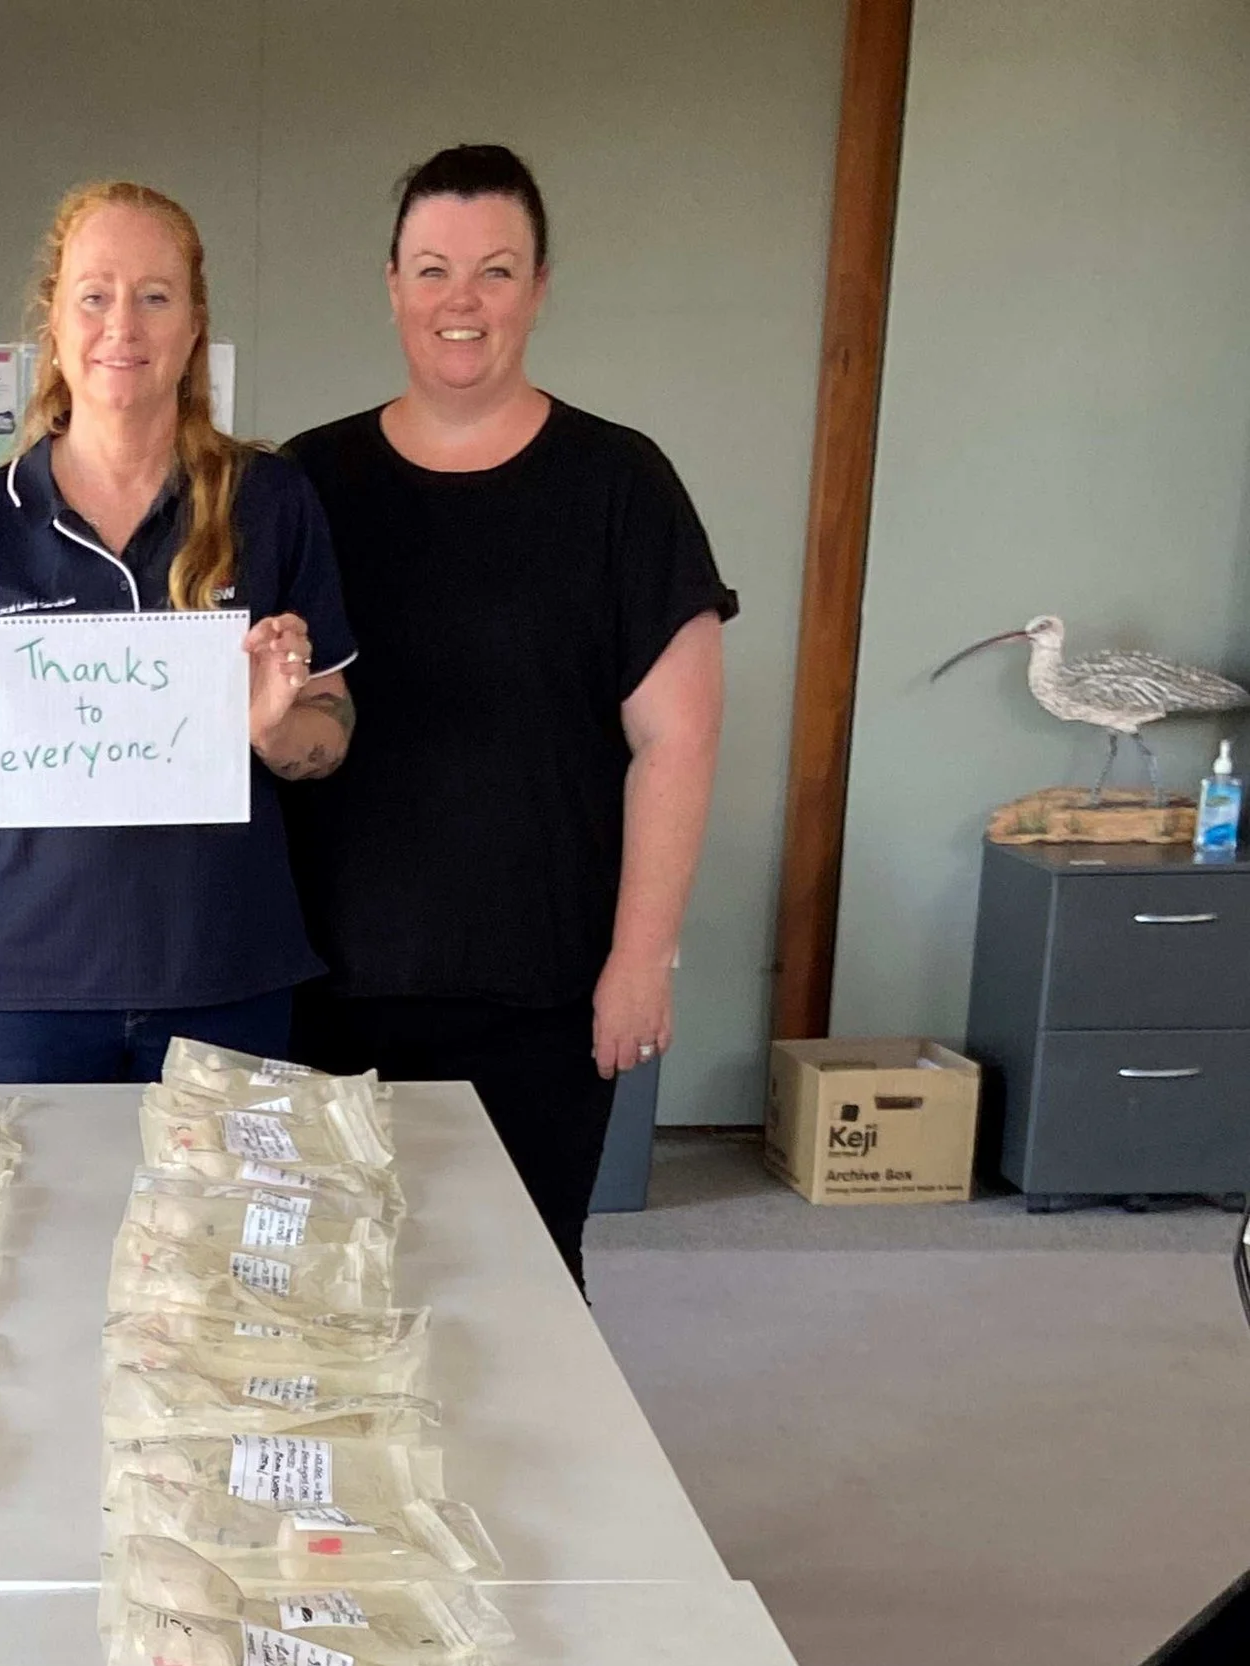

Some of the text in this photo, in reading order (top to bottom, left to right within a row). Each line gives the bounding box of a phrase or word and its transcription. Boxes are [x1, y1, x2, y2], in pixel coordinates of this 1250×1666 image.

[213, 586, 235, 600] SW
[15, 636, 170, 692] Thanks
[76, 697, 103, 726] to
[1, 717, 189, 778] everyone!
[829, 1125, 878, 1157] Keji
[826, 1168, 912, 1182] Archive Box
